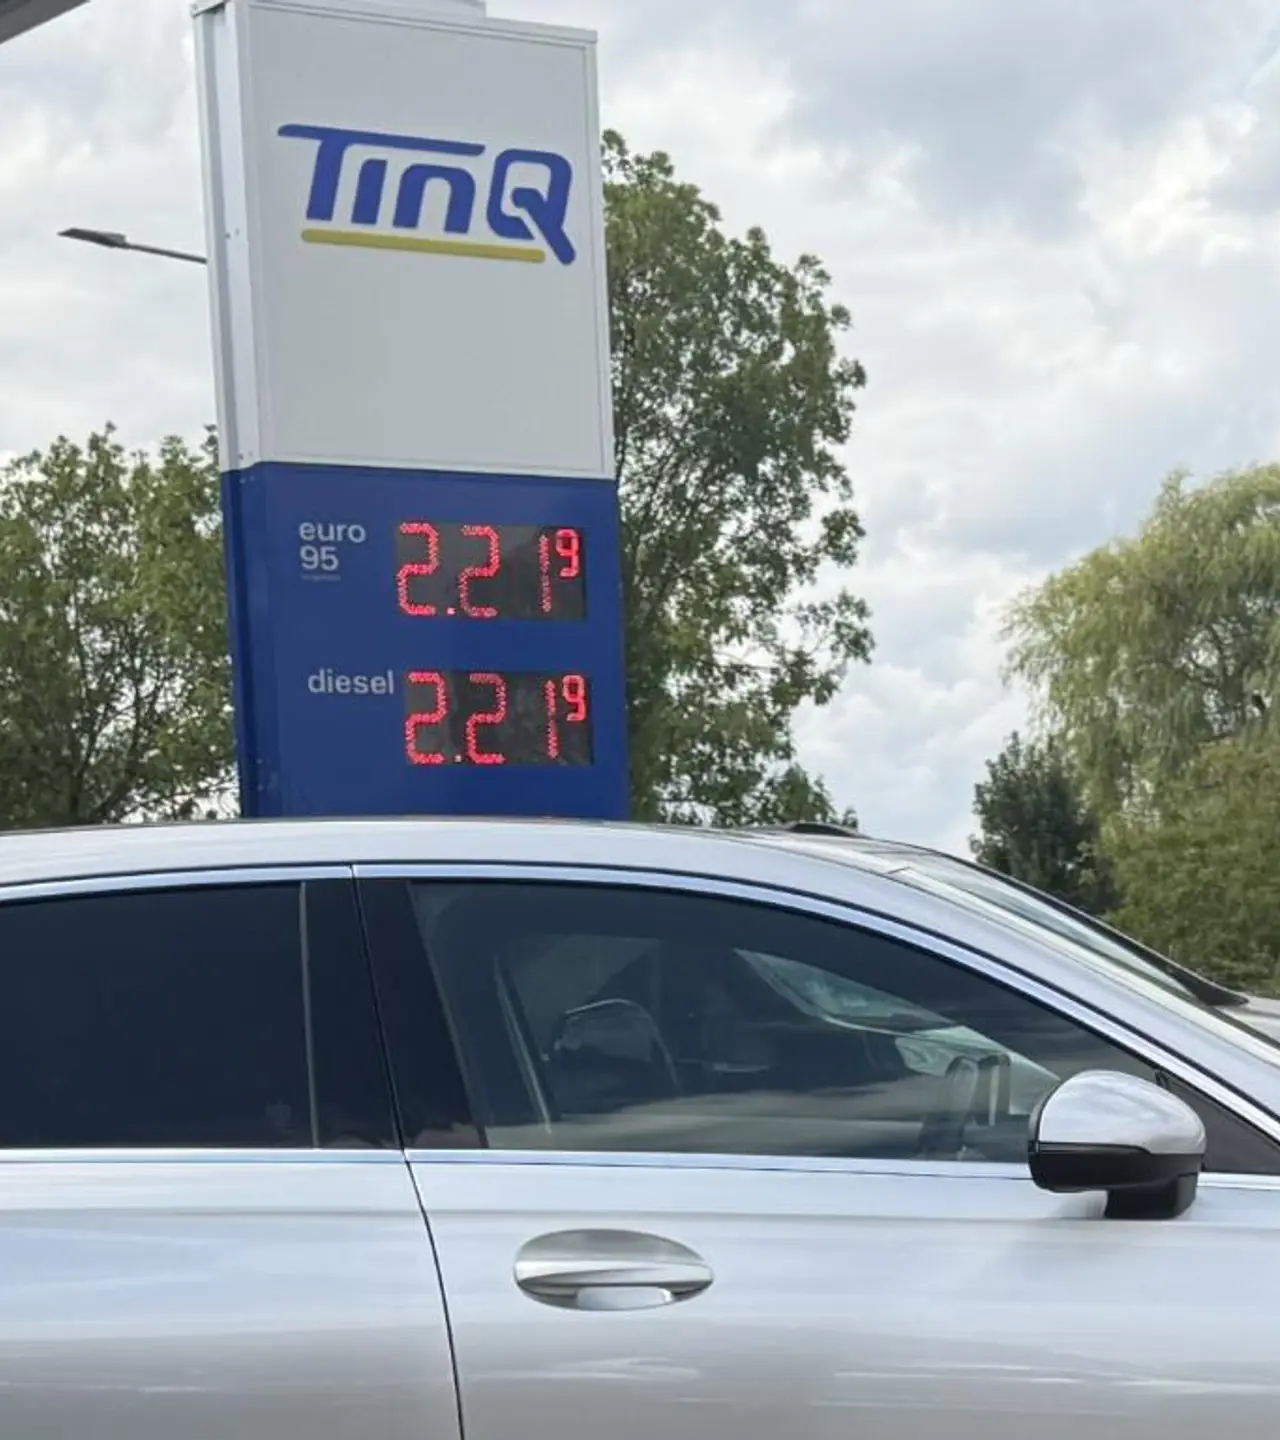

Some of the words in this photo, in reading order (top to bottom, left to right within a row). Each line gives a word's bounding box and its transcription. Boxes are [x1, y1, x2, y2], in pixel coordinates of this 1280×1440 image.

[299, 522, 366, 543] euro
[300, 545, 339, 571] 95
[307, 668, 394, 694] diesel
